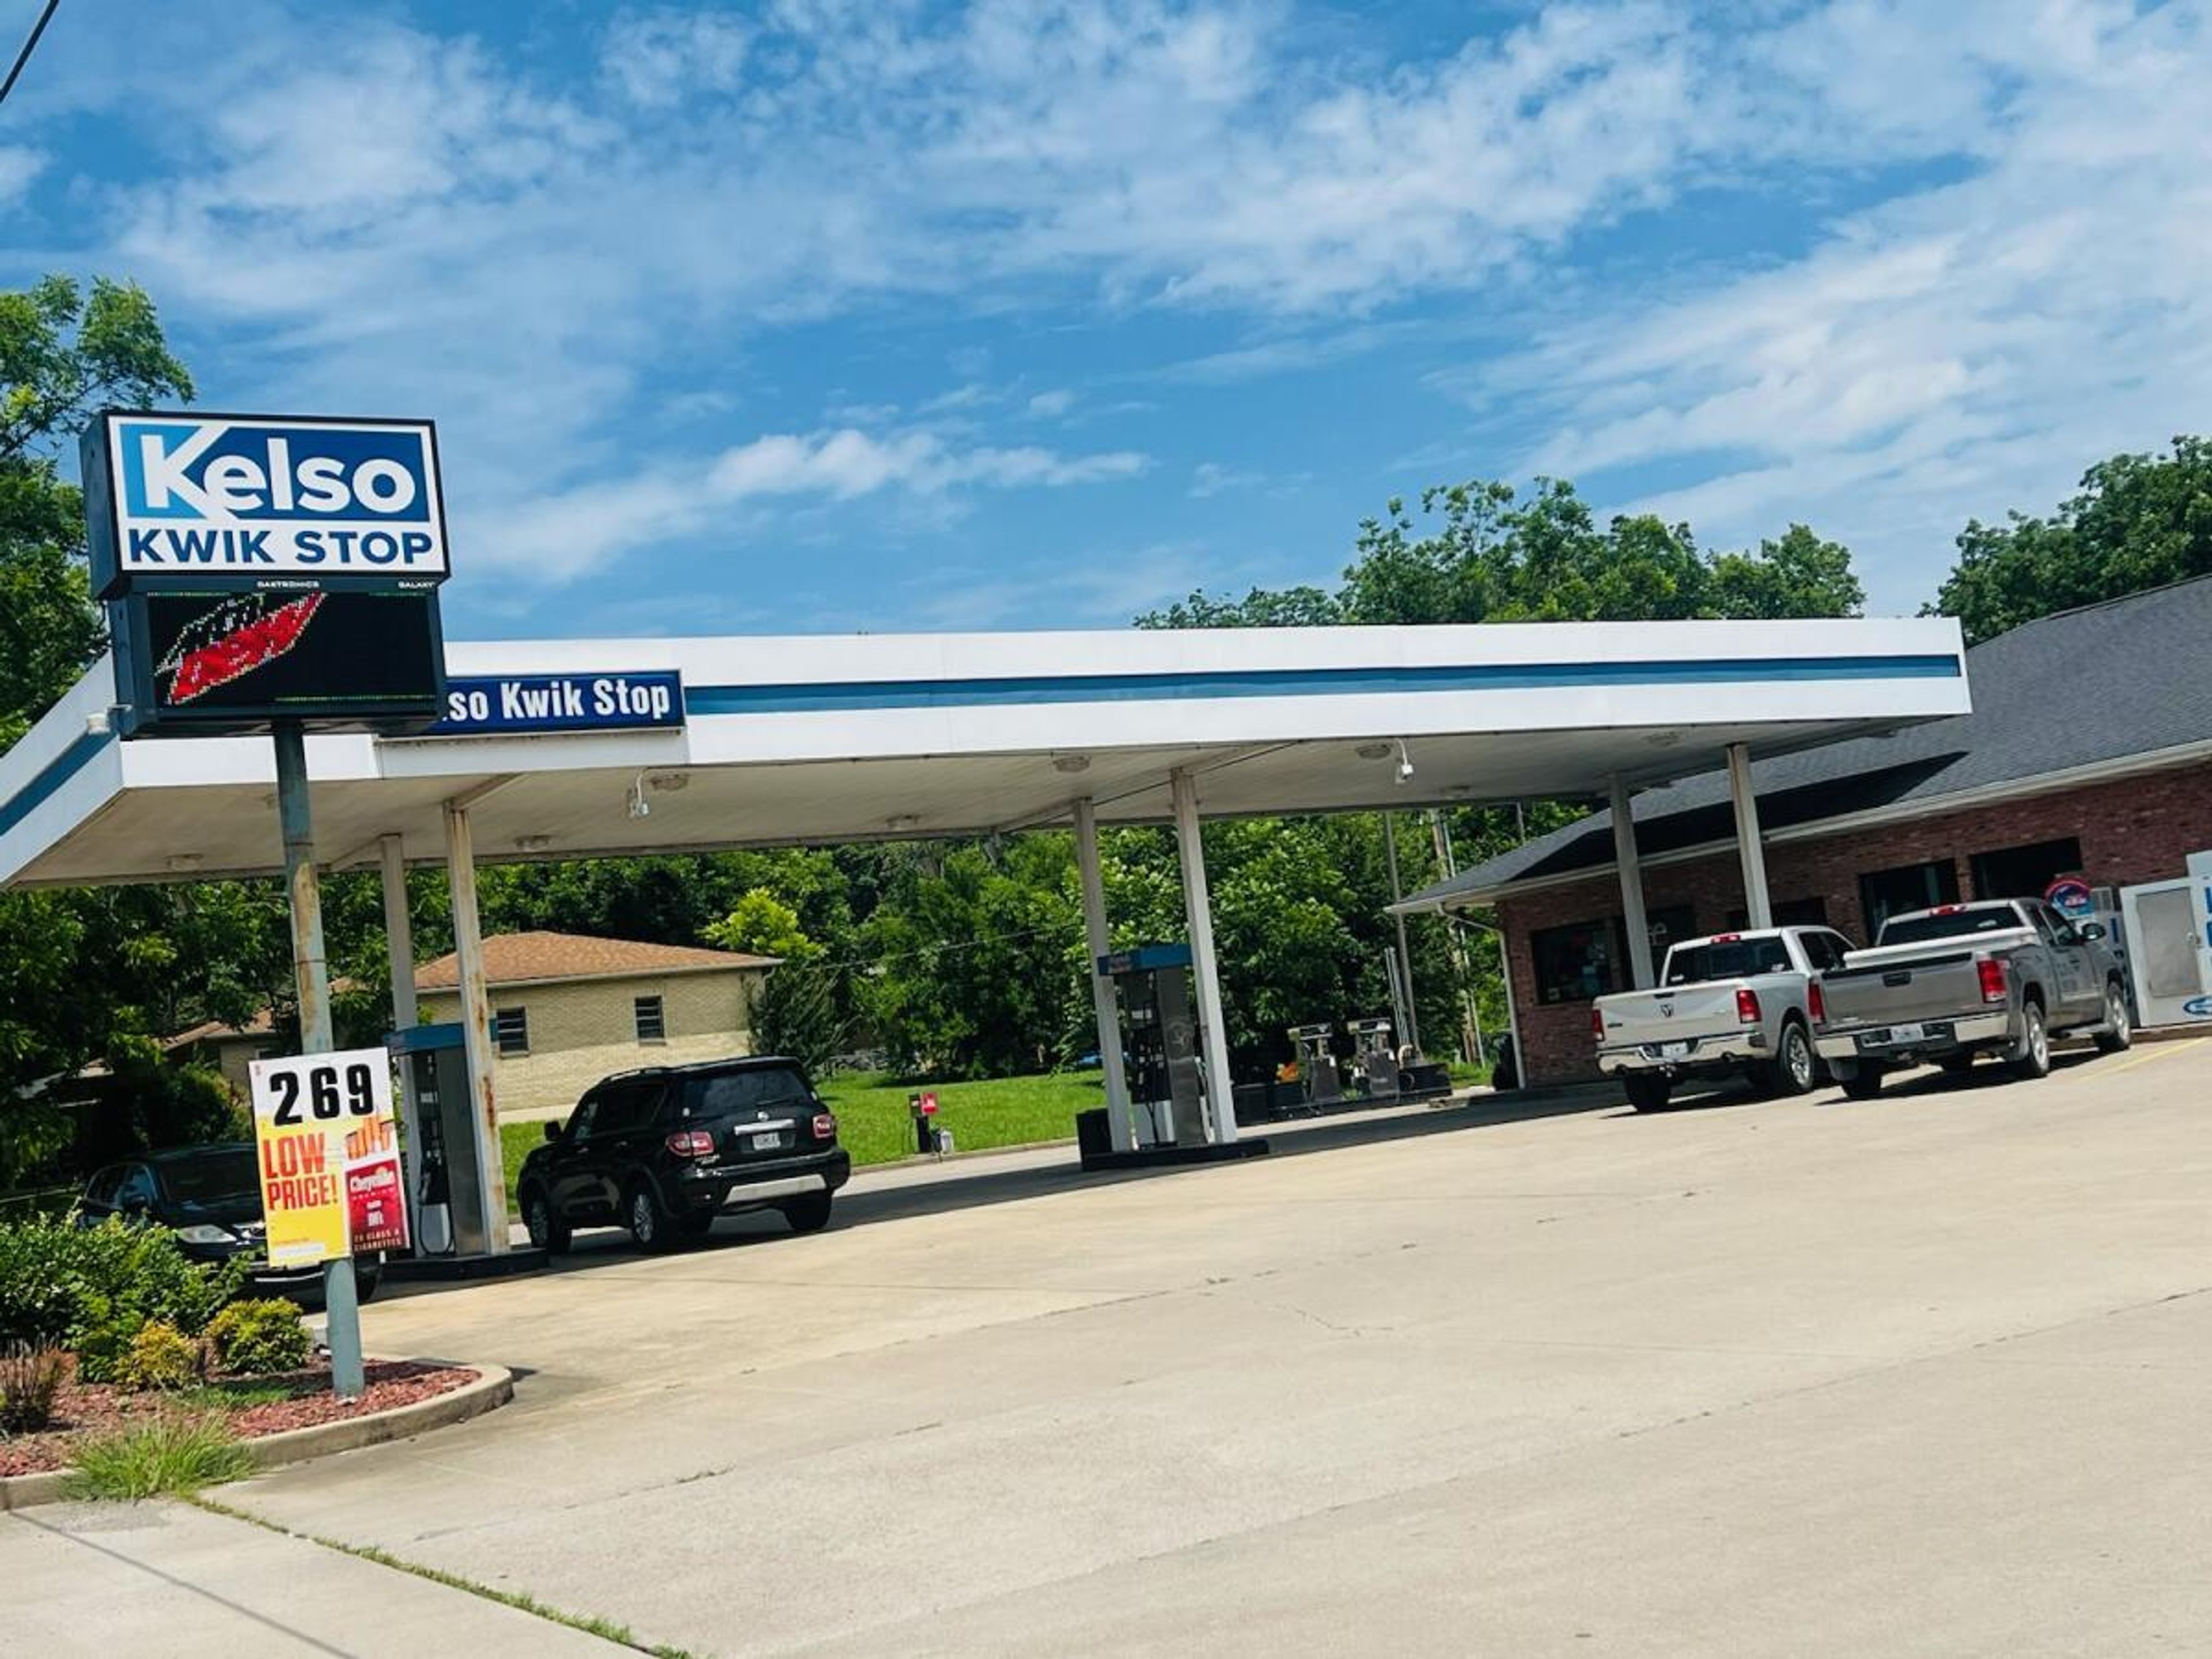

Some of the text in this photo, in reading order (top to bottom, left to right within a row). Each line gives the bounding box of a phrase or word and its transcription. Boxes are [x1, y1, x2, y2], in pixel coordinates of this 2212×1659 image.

[139, 426, 415, 519] Kelso
[129, 529, 432, 564] KWIK STOP
[501, 681, 585, 719] Kwik
[593, 679, 671, 719] Stop
[263, 1131, 325, 1179] LOW
[267, 1175, 338, 1210] PRICE!
